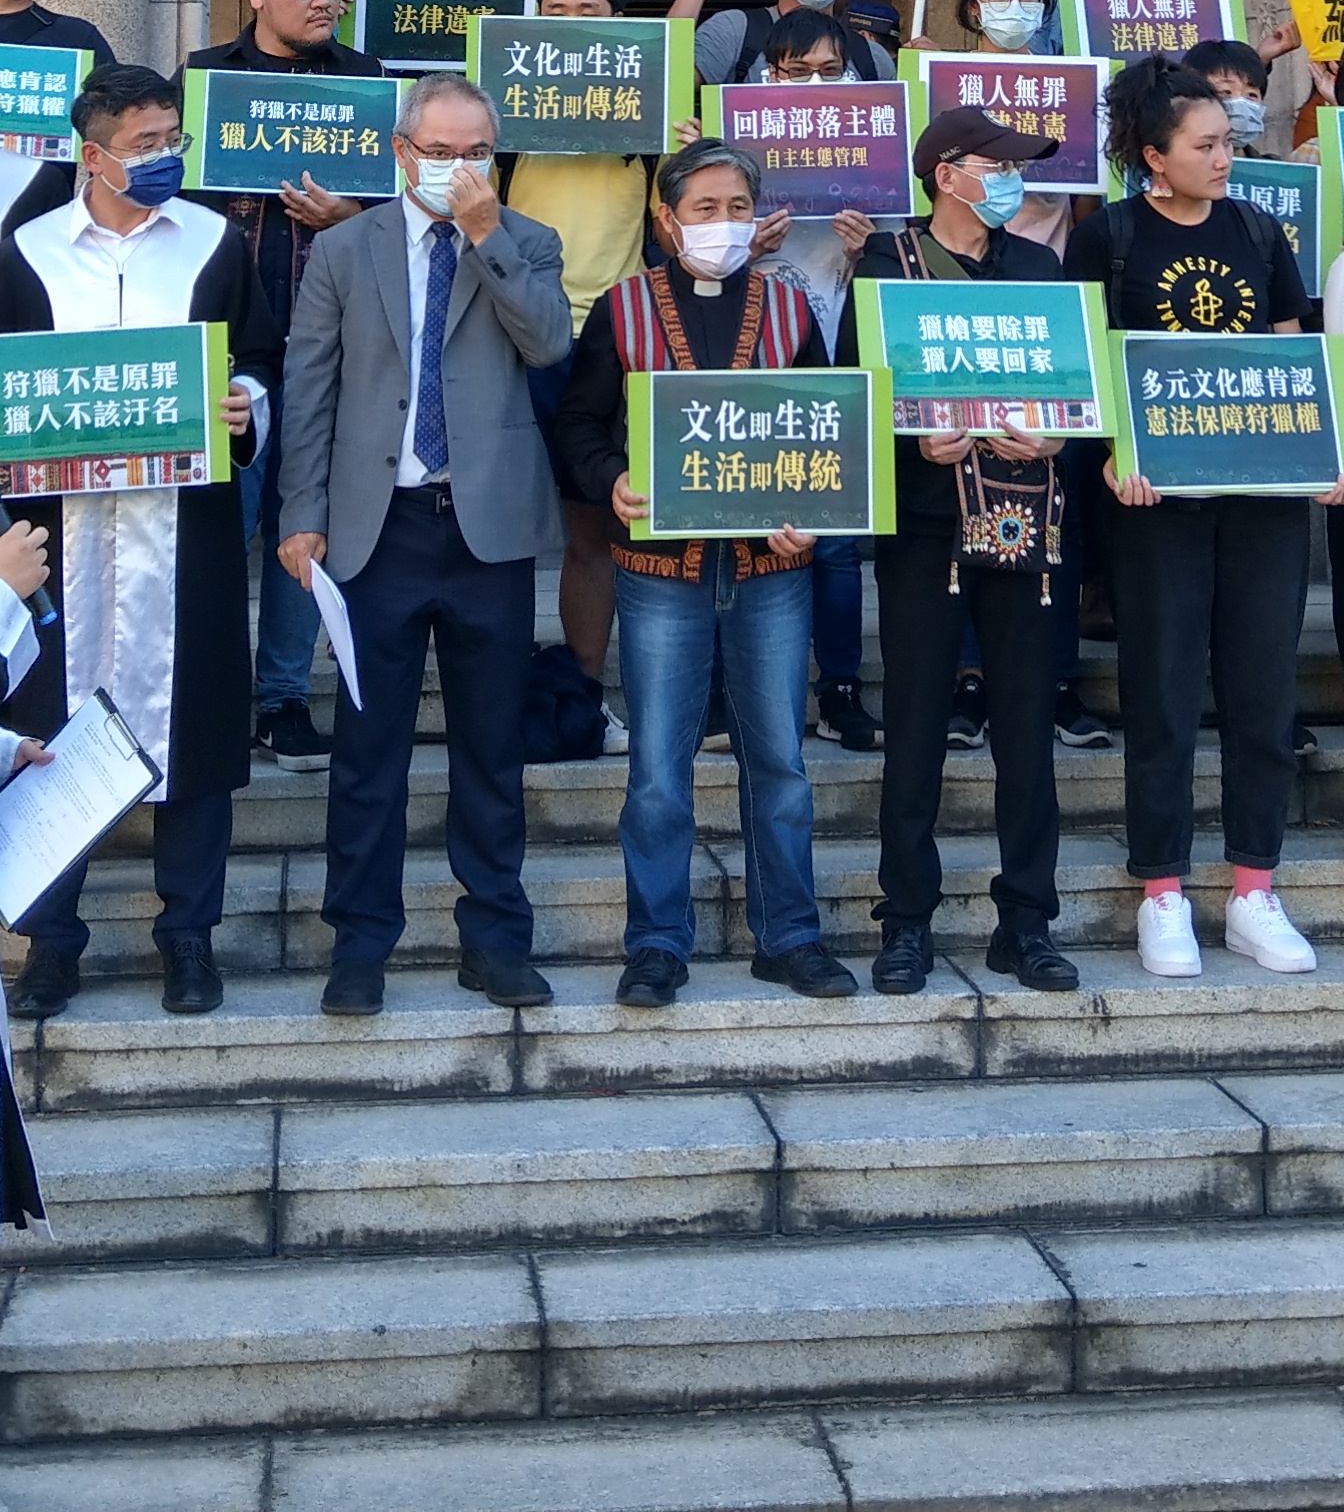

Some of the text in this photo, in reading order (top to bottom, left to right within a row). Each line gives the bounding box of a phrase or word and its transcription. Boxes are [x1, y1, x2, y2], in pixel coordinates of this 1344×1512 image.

[392, 3, 496, 34] 法律違
[1110, 21, 1199, 52] 法律違憲
[503, 40, 643, 80] 文化即生活
[502, 84, 642, 123] 生活即傳統
[957, 74, 1068, 108] 獵人無罪
[248, 100, 355, 123] 狩獵不是原罪
[733, 104, 898, 140] 回歸部落主體
[765, 146, 869, 170] 自主生態管理
[1157, 255, 1231, 293] AMNESTY
[918, 314, 1052, 343] 獵槍要除罪
[921, 345, 1054, 375] 獵人要回家
[2, 360, 179, 400] 狩獵不是原罪
[1141, 366, 1317, 400] 多元文化應肯認
[679, 399, 842, 443] 文化即生活
[1146, 401, 1323, 437] 憲法保障狩獵權
[680, 449, 842, 494] 生活即傳統
